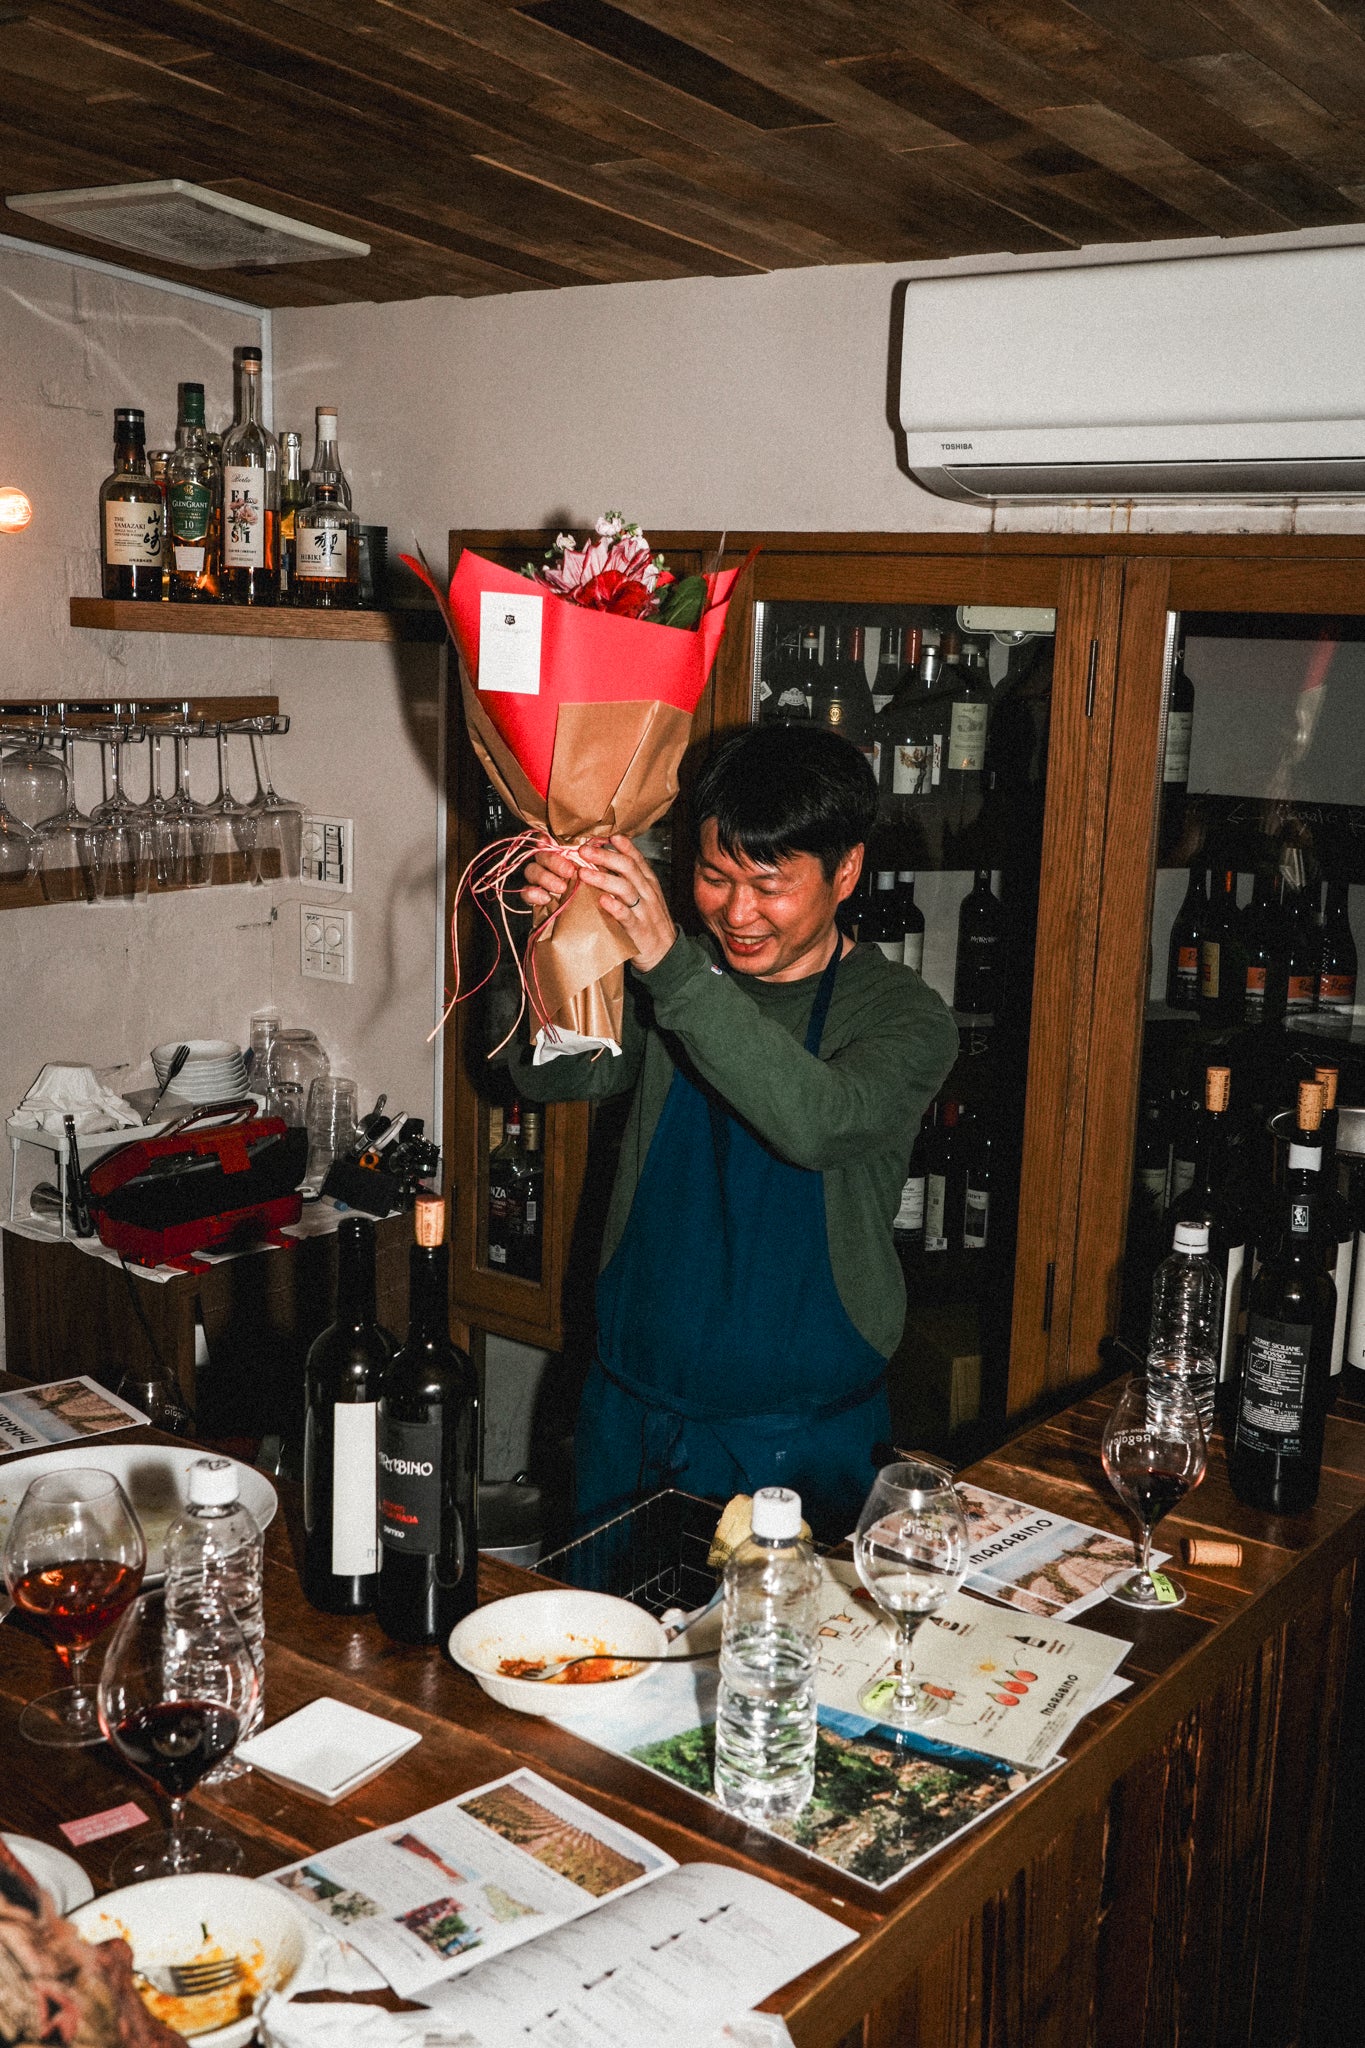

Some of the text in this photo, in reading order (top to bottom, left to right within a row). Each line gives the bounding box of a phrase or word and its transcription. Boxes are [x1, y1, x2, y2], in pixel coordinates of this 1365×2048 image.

[113, 522, 146, 530] YAMAZAKI
[184, 520, 195, 529] 10
[1040, 1674, 1079, 1717] MARABINO
